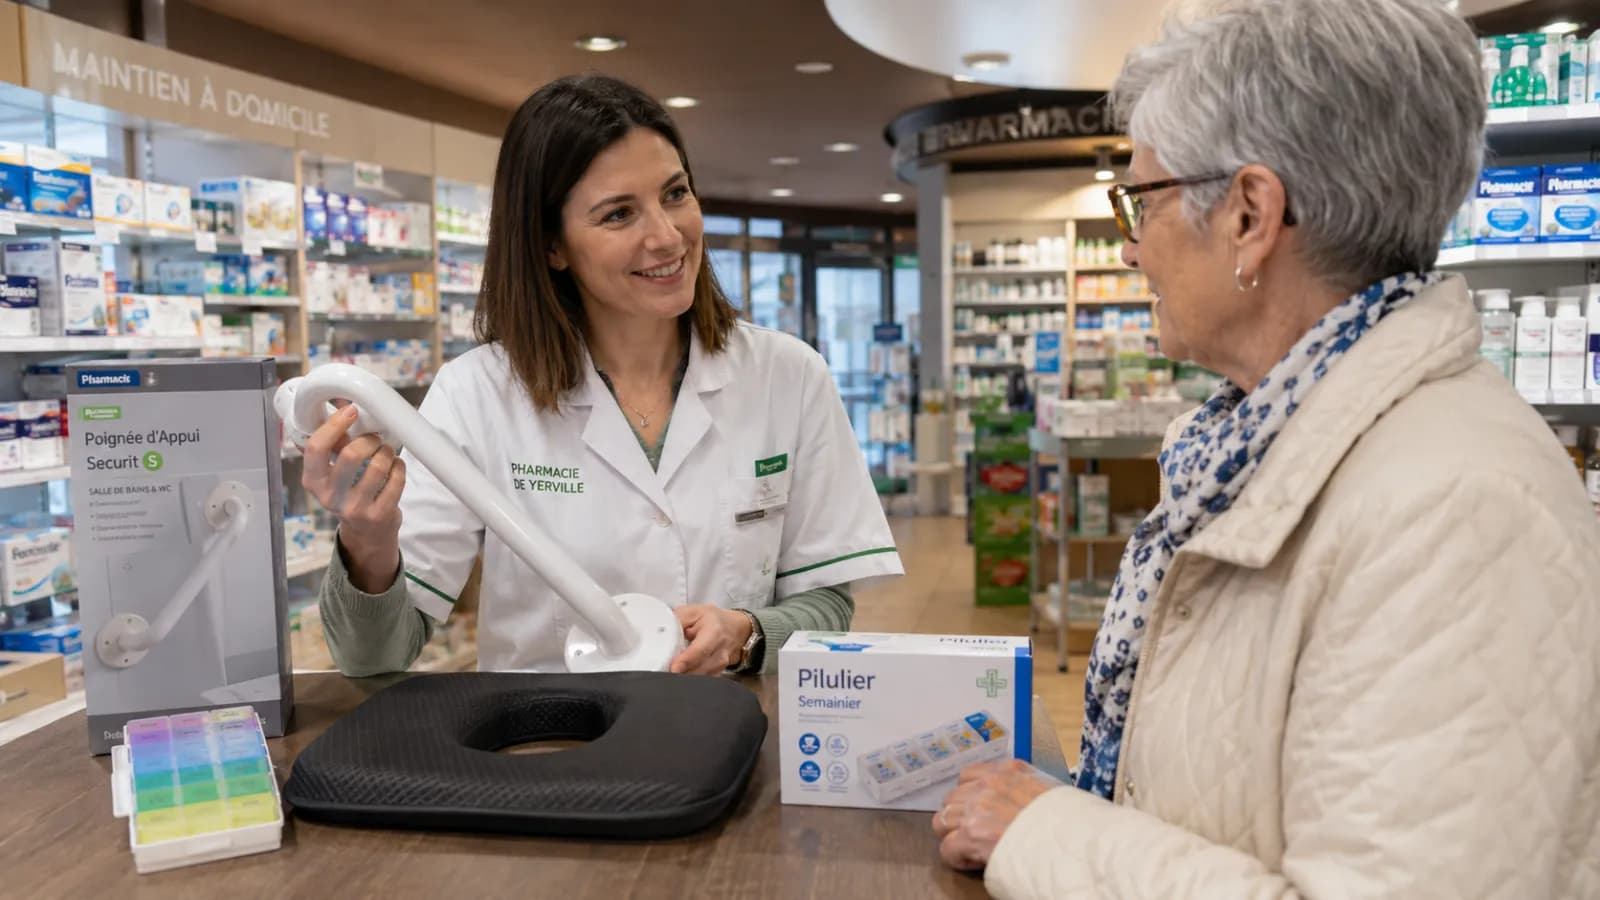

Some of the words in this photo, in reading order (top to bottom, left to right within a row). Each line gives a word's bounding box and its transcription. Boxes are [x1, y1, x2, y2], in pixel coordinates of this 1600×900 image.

[54, 41, 190, 106] MAINTIEN
[200, 77, 218, 112] À
[226, 90, 330, 138] DOMICILE
[85, 431, 143, 448] Poignée
[147, 429, 200, 446] d'Appui
[87, 455, 139, 470] Securit
[147, 454, 158, 468] S
[511, 463, 580, 479] PHARMACIE
[88, 487, 112, 496] SALLE
[114, 486, 125, 495] DE
[126, 485, 149, 494] BAINS
[159, 484, 172, 492] WC
[513, 478, 526, 490] DE
[528, 479, 585, 493] YERVILLE
[798, 668, 876, 690] Pilulier
[798, 695, 862, 709] Semainier
